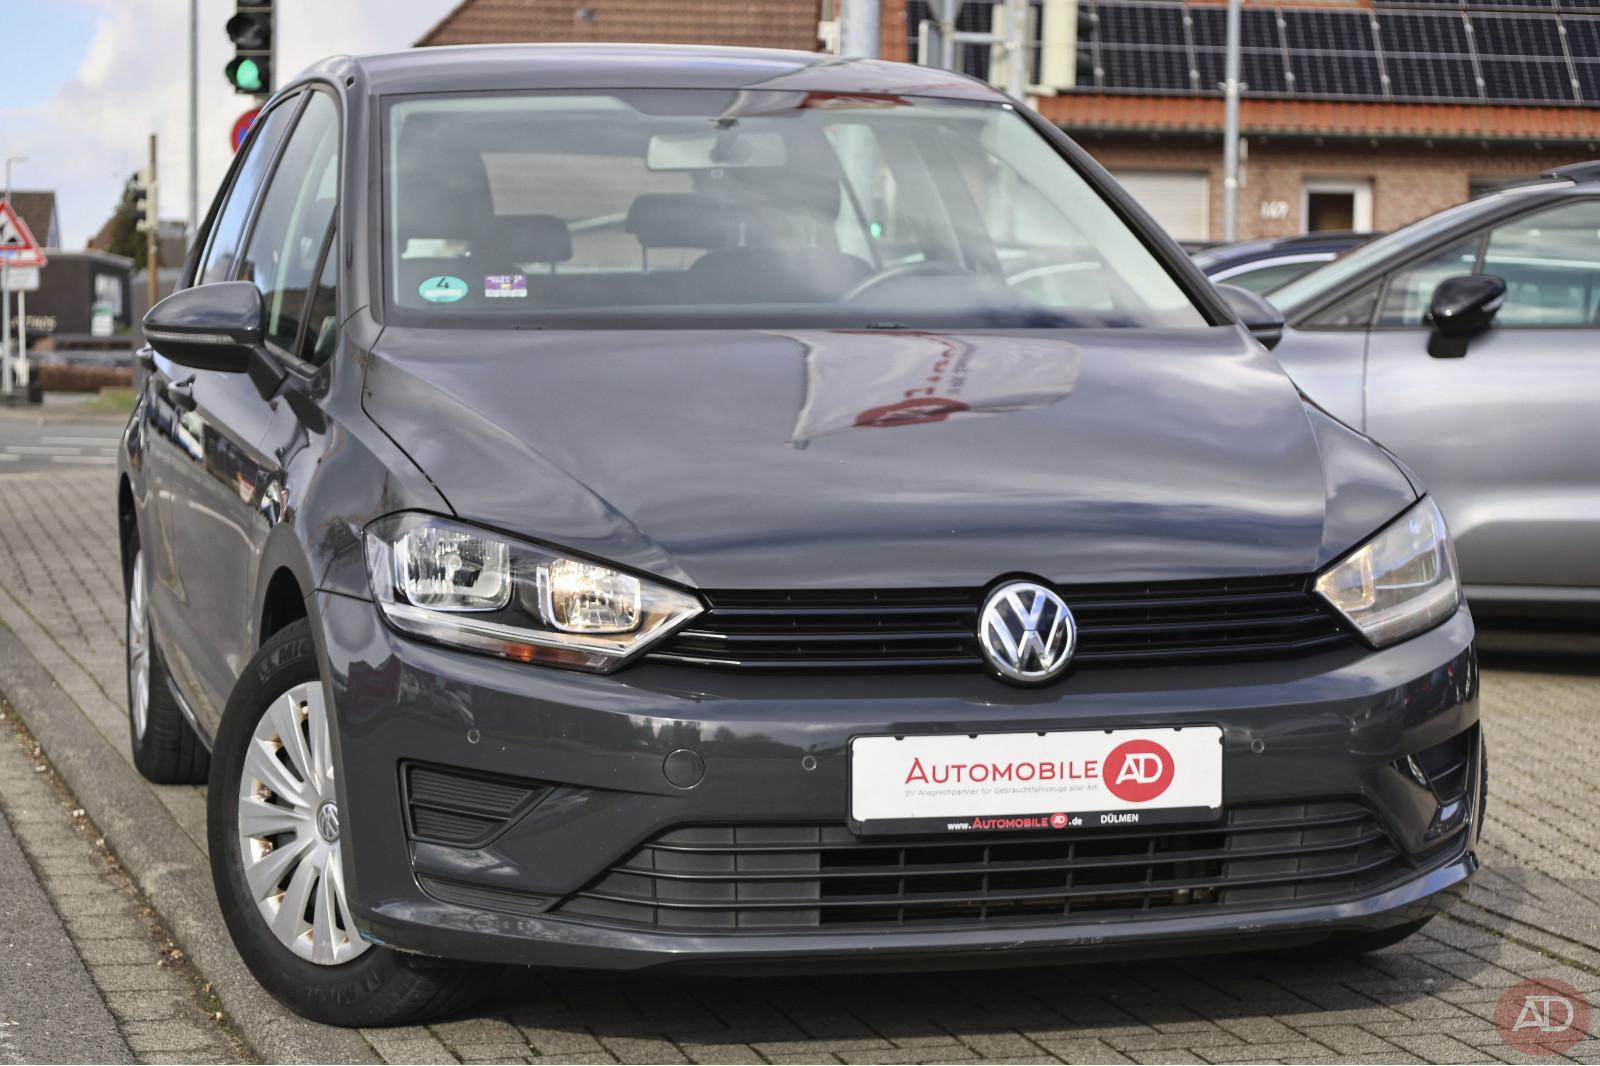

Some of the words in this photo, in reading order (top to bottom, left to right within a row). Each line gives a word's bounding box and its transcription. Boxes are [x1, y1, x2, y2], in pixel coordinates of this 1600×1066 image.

[436, 277, 449, 289] 4
[982, 583, 1075, 677] VW
[1114, 752, 1164, 785] AD
[904, 789, 915, 798] Ihr
[918, 787, 979, 796] Ansprechpartner
[981, 786, 991, 795] für
[1069, 783, 1085, 792] aller
[1087, 783, 1098, 792] Art
[1100, 813, 1139, 824] DÜLMEN
